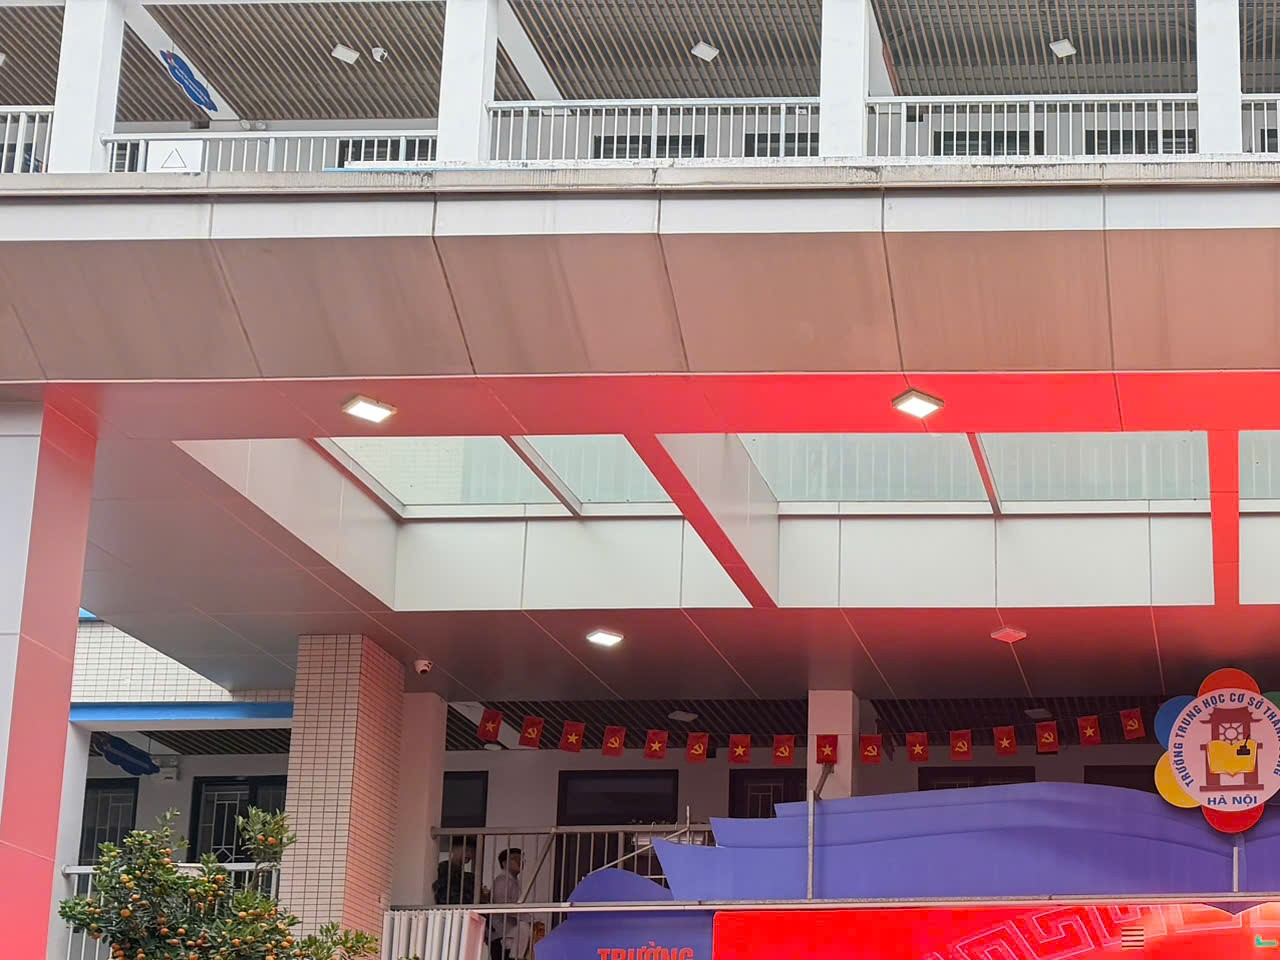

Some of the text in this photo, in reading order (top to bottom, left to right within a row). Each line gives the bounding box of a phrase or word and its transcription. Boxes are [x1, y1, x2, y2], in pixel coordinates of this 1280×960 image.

[1202, 693, 1225, 708] HỌC
[1229, 692, 1245, 703] CƠ
[1247, 696, 1264, 710] SỞ
[1175, 705, 1202, 739] TRUNG
[1173, 742, 1194, 788] TRƯỜNG
[1207, 794, 1258, 807] HÀ NỘI
